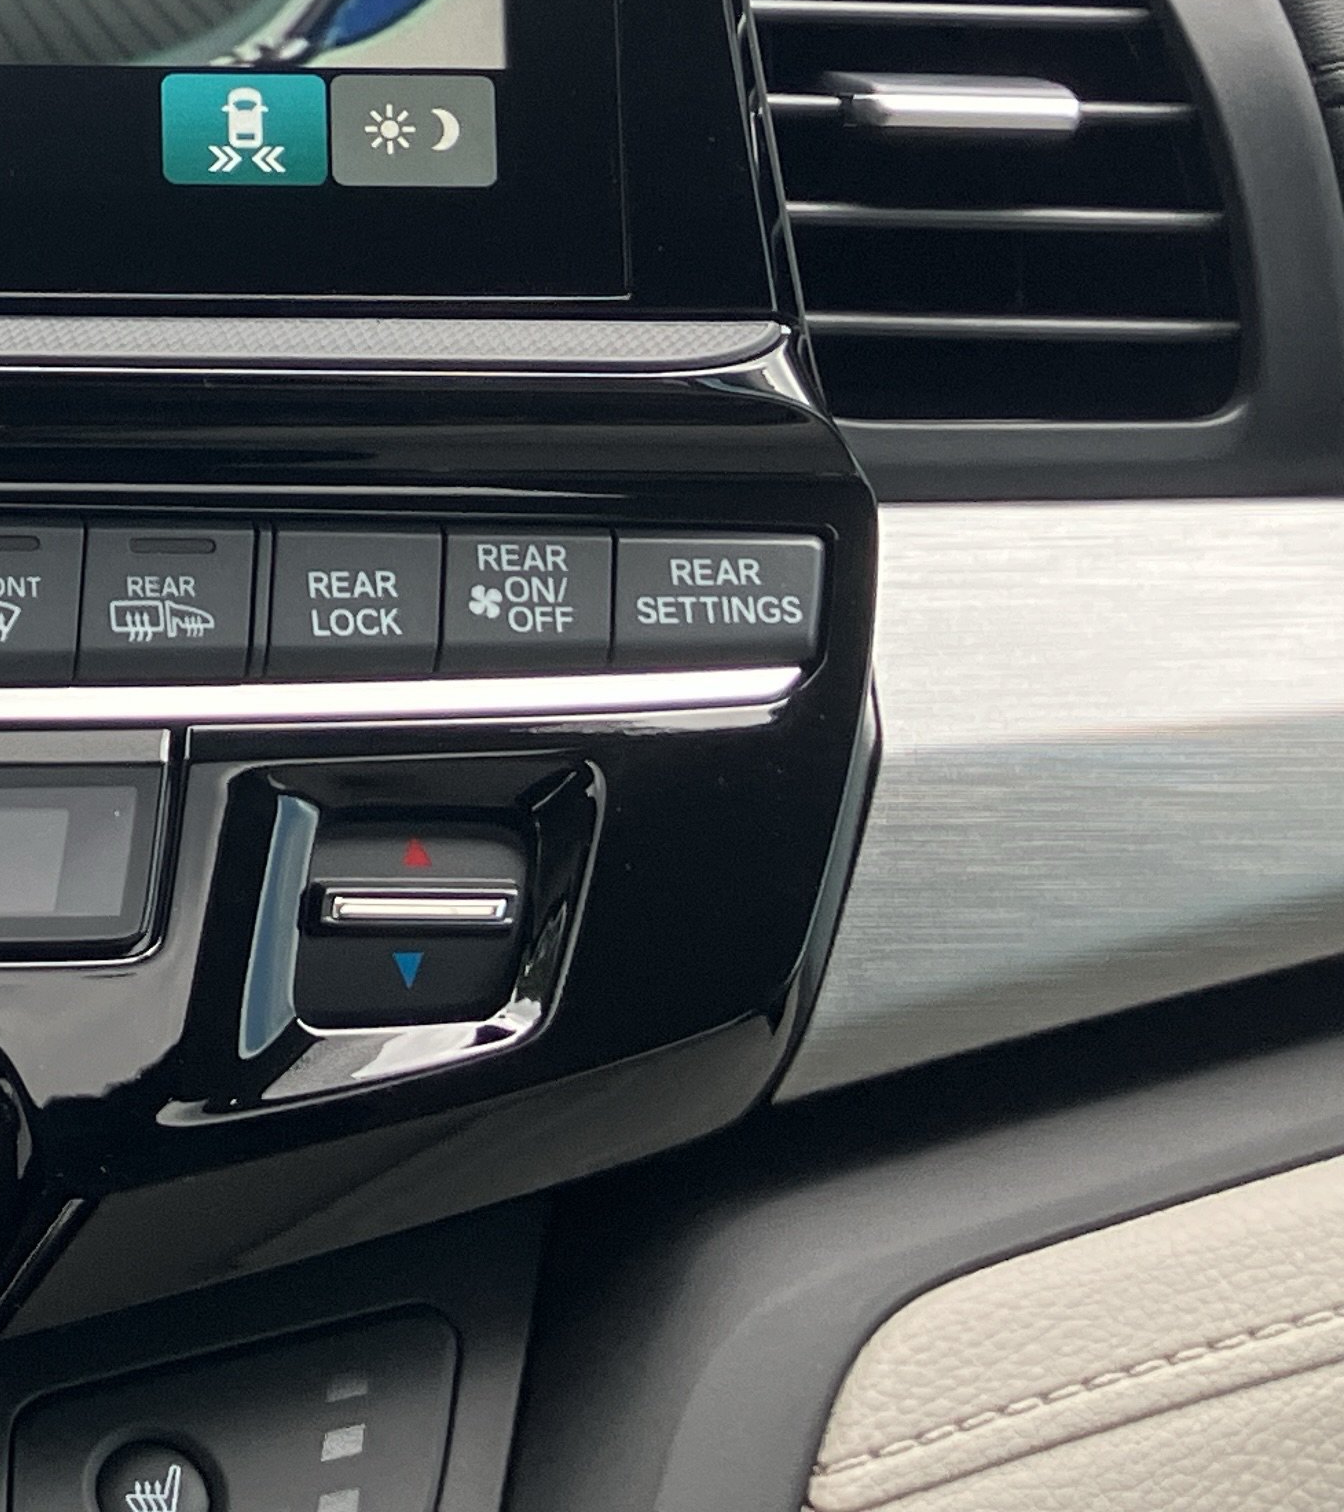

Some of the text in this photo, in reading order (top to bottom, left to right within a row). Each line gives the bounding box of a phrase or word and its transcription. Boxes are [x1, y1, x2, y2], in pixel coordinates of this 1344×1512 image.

[476, 543, 569, 573] REAR
[669, 557, 763, 587] REAR
[126, 575, 197, 599] REAR
[307, 570, 399, 599] REAR
[503, 575, 569, 604] ON/
[310, 607, 404, 637] LOCK
[507, 605, 574, 634] OFF
[635, 594, 804, 625] SETTINGS
